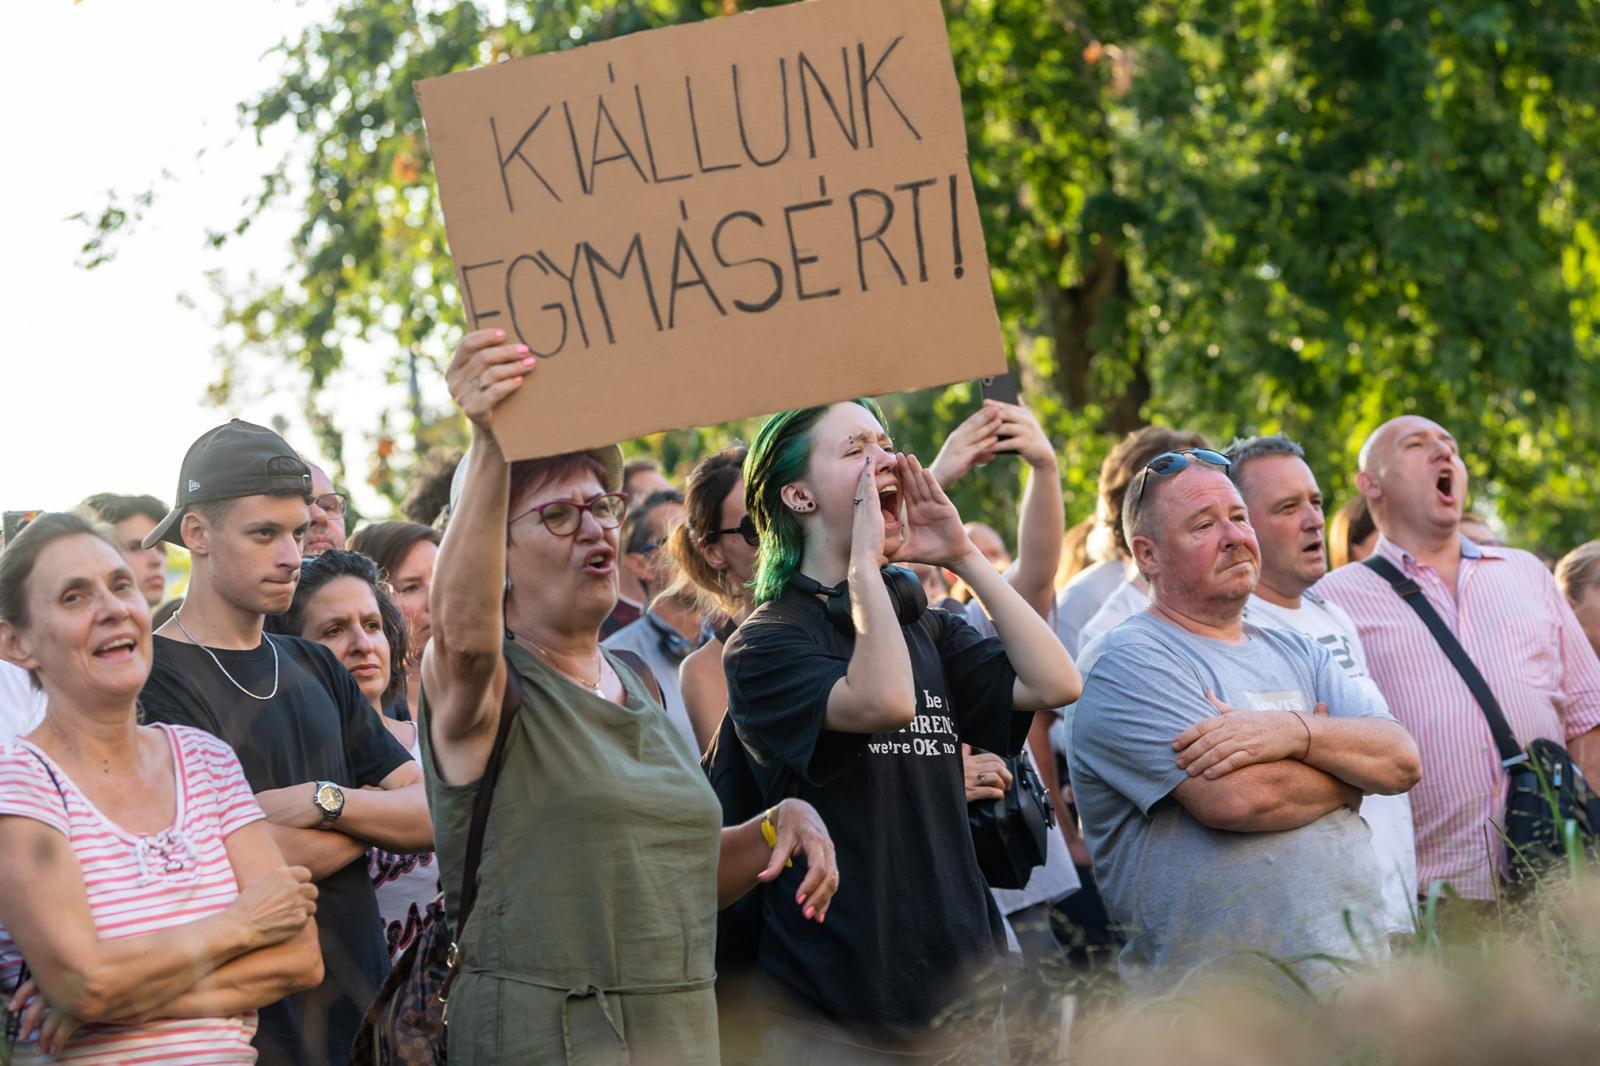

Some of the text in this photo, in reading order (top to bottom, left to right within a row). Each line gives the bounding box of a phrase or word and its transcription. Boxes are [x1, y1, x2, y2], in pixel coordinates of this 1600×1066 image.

[489, 34, 923, 213] KIÁLLUNK
[923, 689, 942, 708] be
[868, 741, 911, 754] we're
[913, 738, 941, 756] OK
